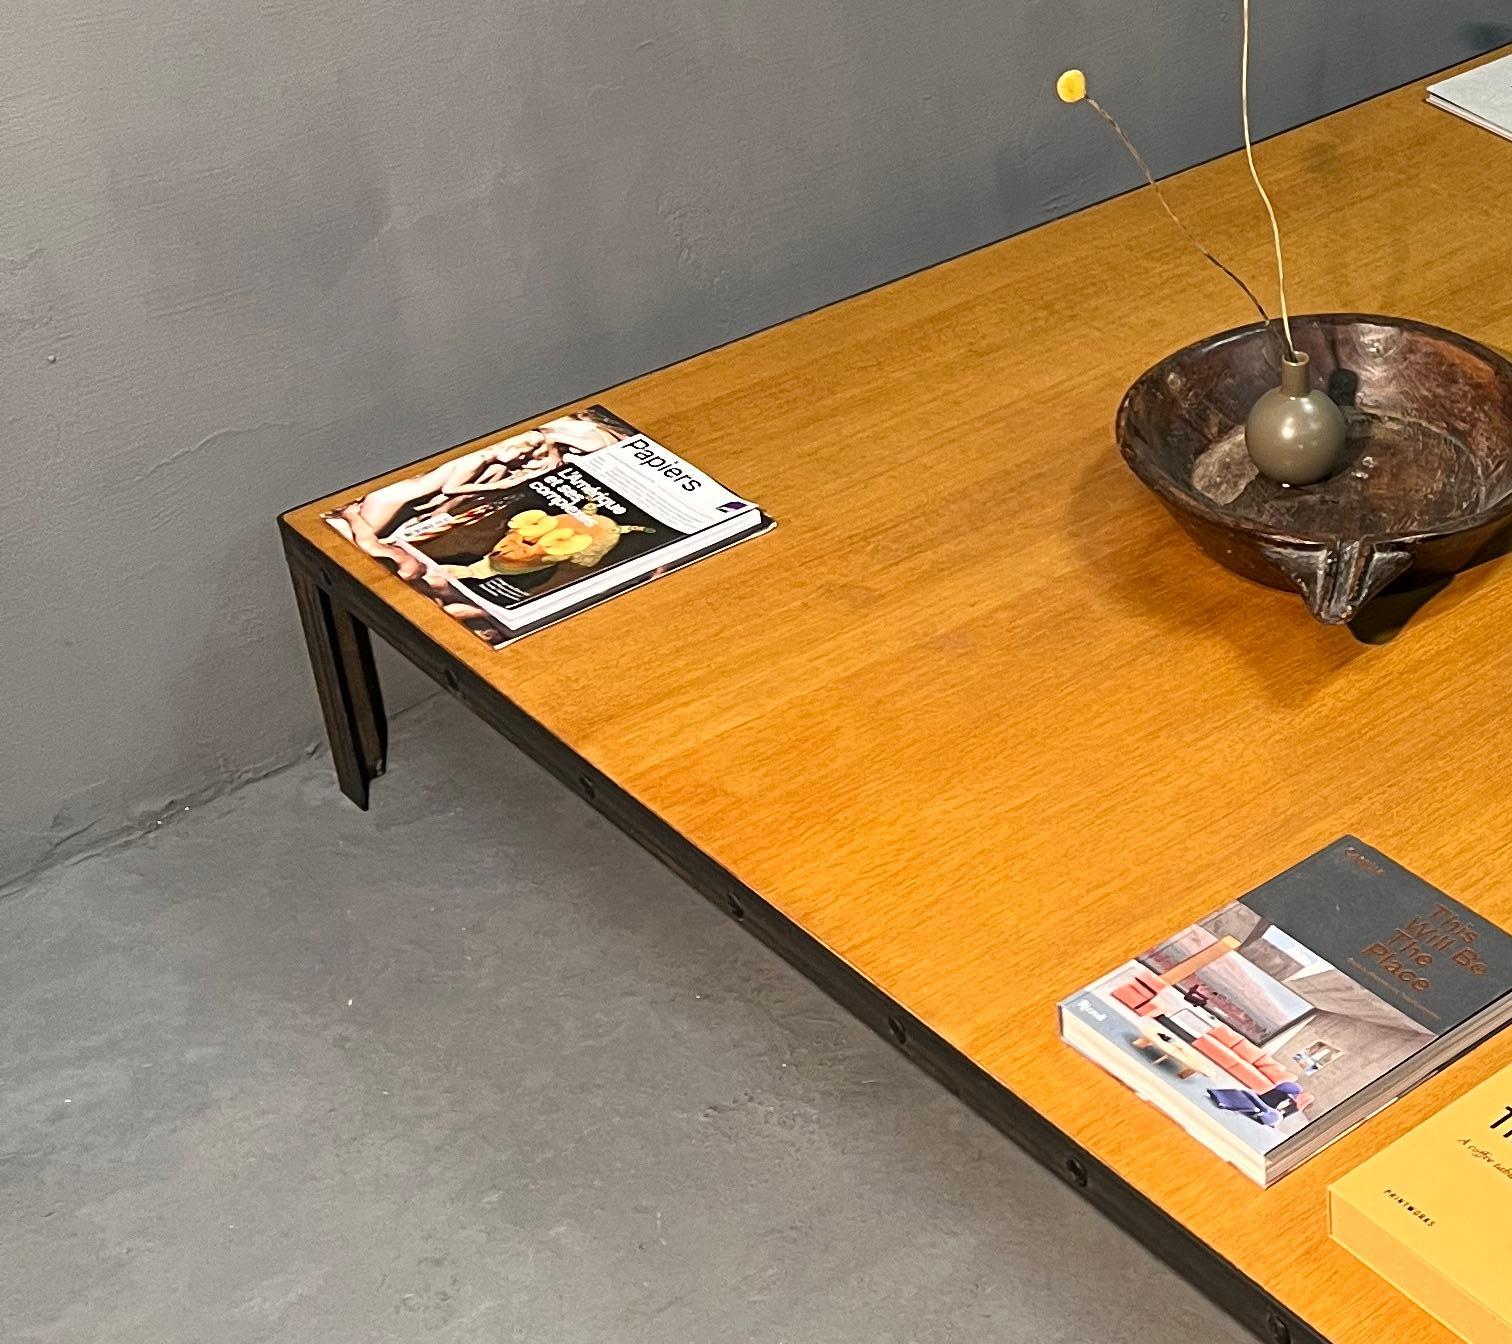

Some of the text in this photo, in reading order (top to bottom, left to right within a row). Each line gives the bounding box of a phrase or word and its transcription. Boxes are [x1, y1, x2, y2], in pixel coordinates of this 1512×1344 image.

[544, 475, 564, 488] et
[620, 439, 702, 492] Papiers
[557, 467, 627, 515] L'Amérique
[1386, 927, 1433, 967] The
[1407, 915, 1488, 976] Will Be
[1429, 903, 1479, 945] This
[1360, 942, 1431, 992] Place
